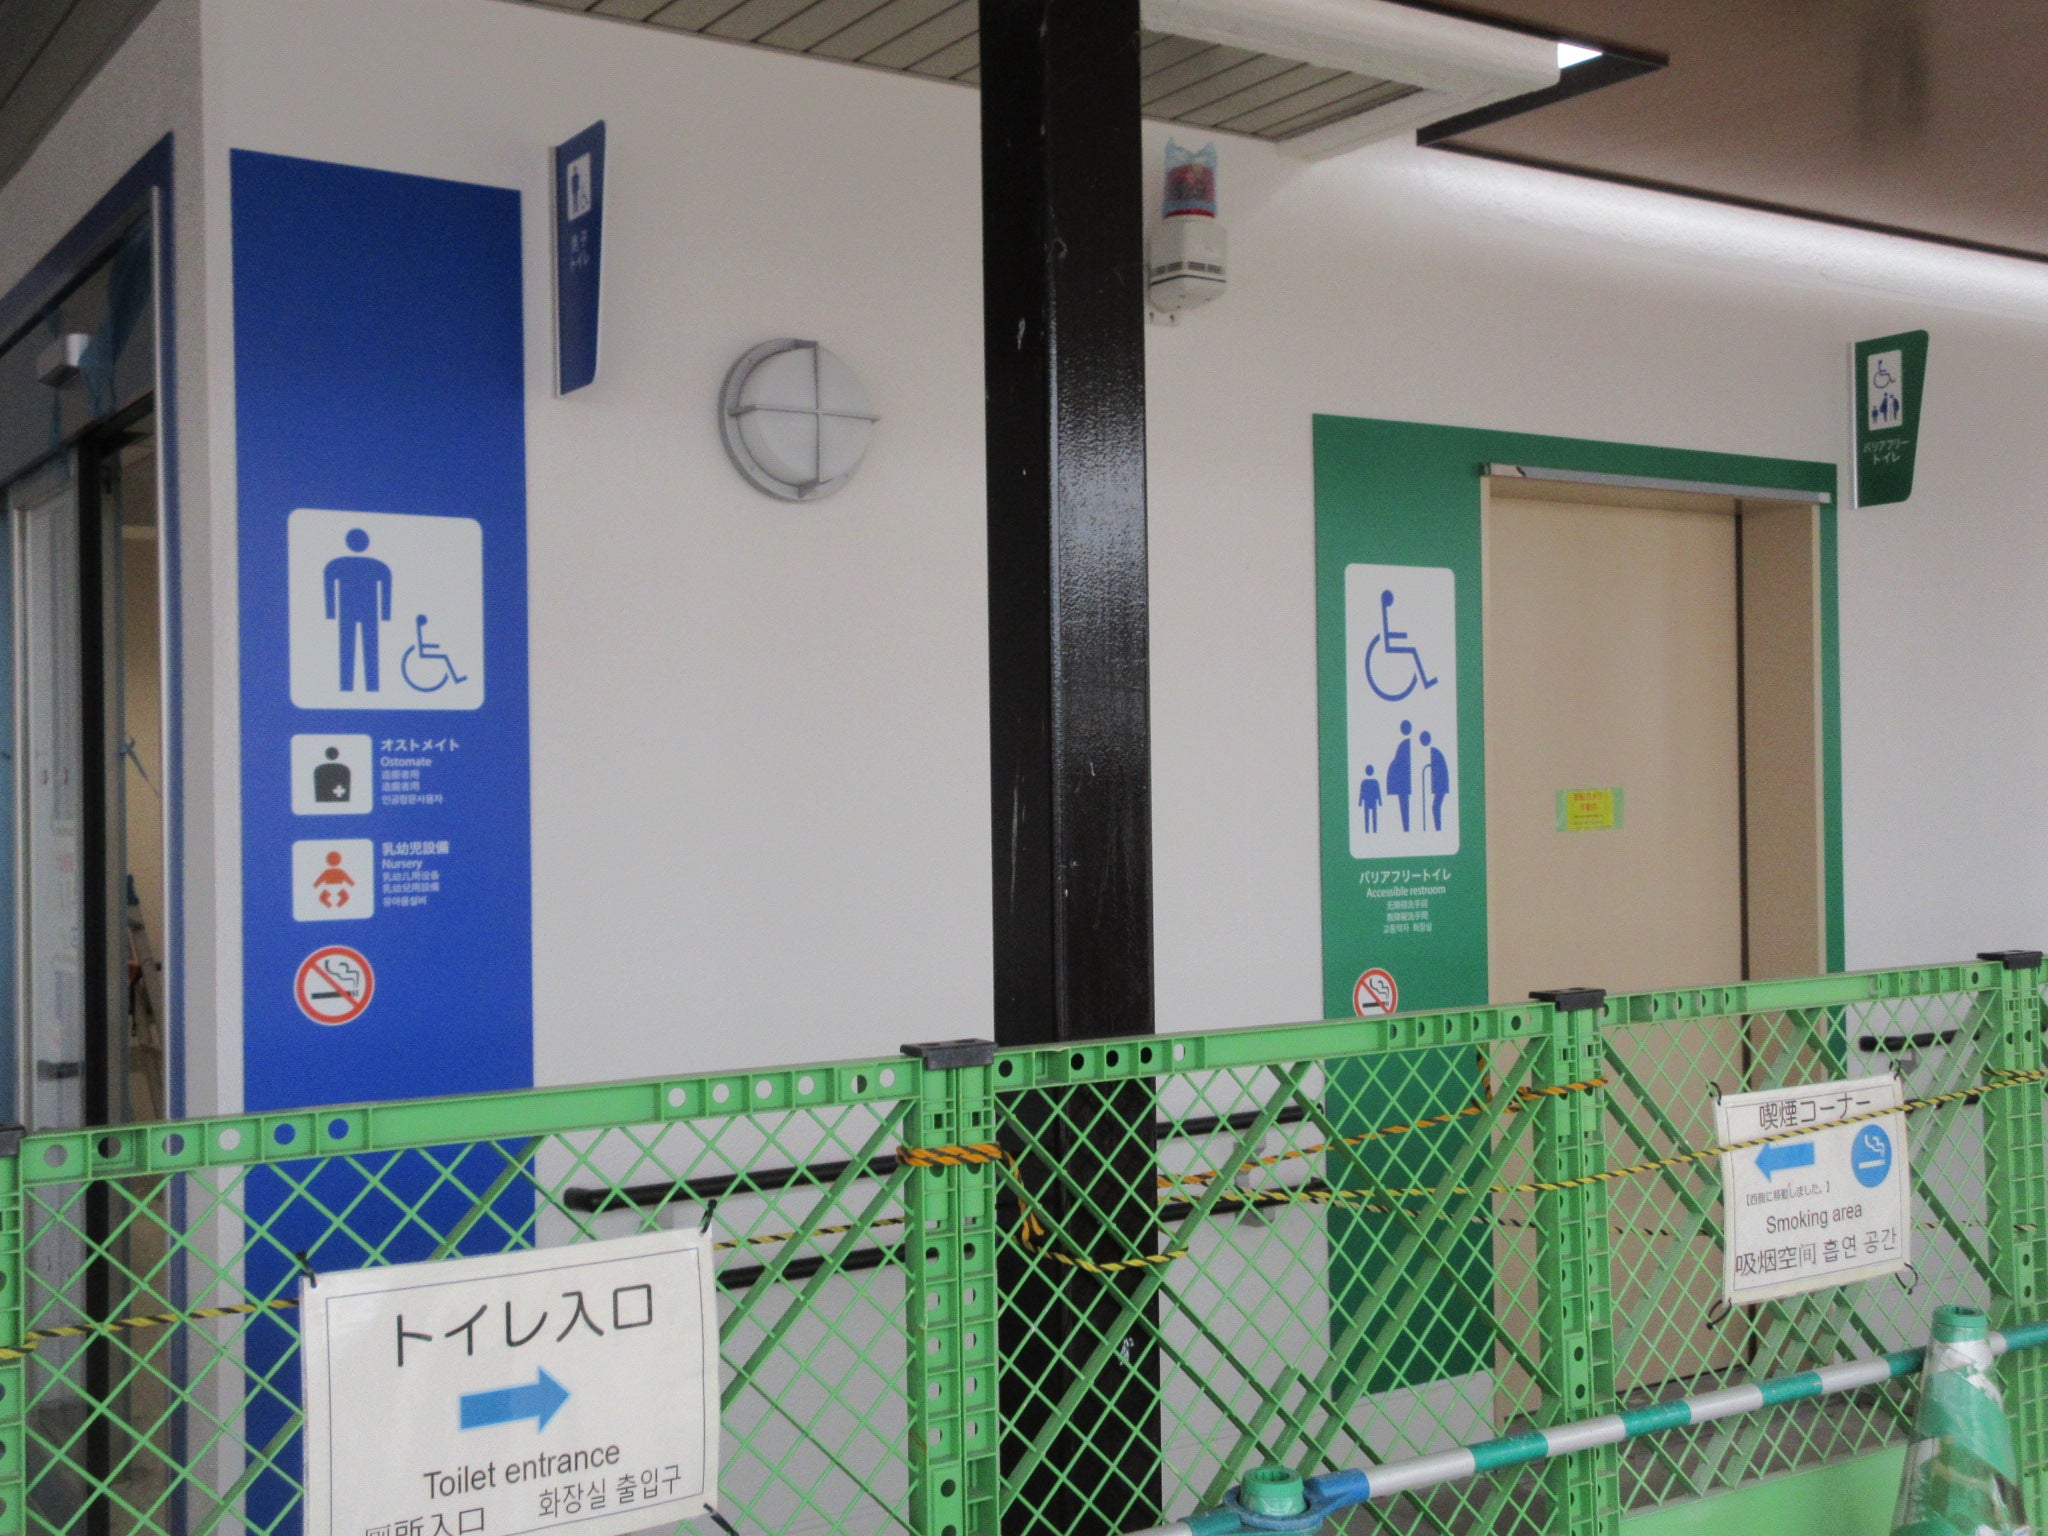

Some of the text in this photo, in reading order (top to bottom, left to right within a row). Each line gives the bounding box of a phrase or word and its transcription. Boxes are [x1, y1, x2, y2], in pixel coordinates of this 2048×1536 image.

[1873, 451, 1901, 465] トイレ
[381, 739, 459, 751] オストメイト
[381, 757, 432, 767] Ostomate
[382, 841, 449, 855] 乳幼児設備
[382, 859, 422, 870] Nursery
[1359, 868, 1451, 884] バリアフリートイレ
[1367, 886, 1446, 898] Accessible restroom
[1759, 1092, 1871, 1131] 喫煙コーナー
[1766, 1202, 1863, 1235] Smoking area
[1735, 1226, 1898, 1277] 吸烟空间 흡연 공간
[396, 1282, 654, 1368] トイレ入口
[424, 1443, 621, 1501] Toilet entrance
[537, 1464, 683, 1520] 화장실 출입구
